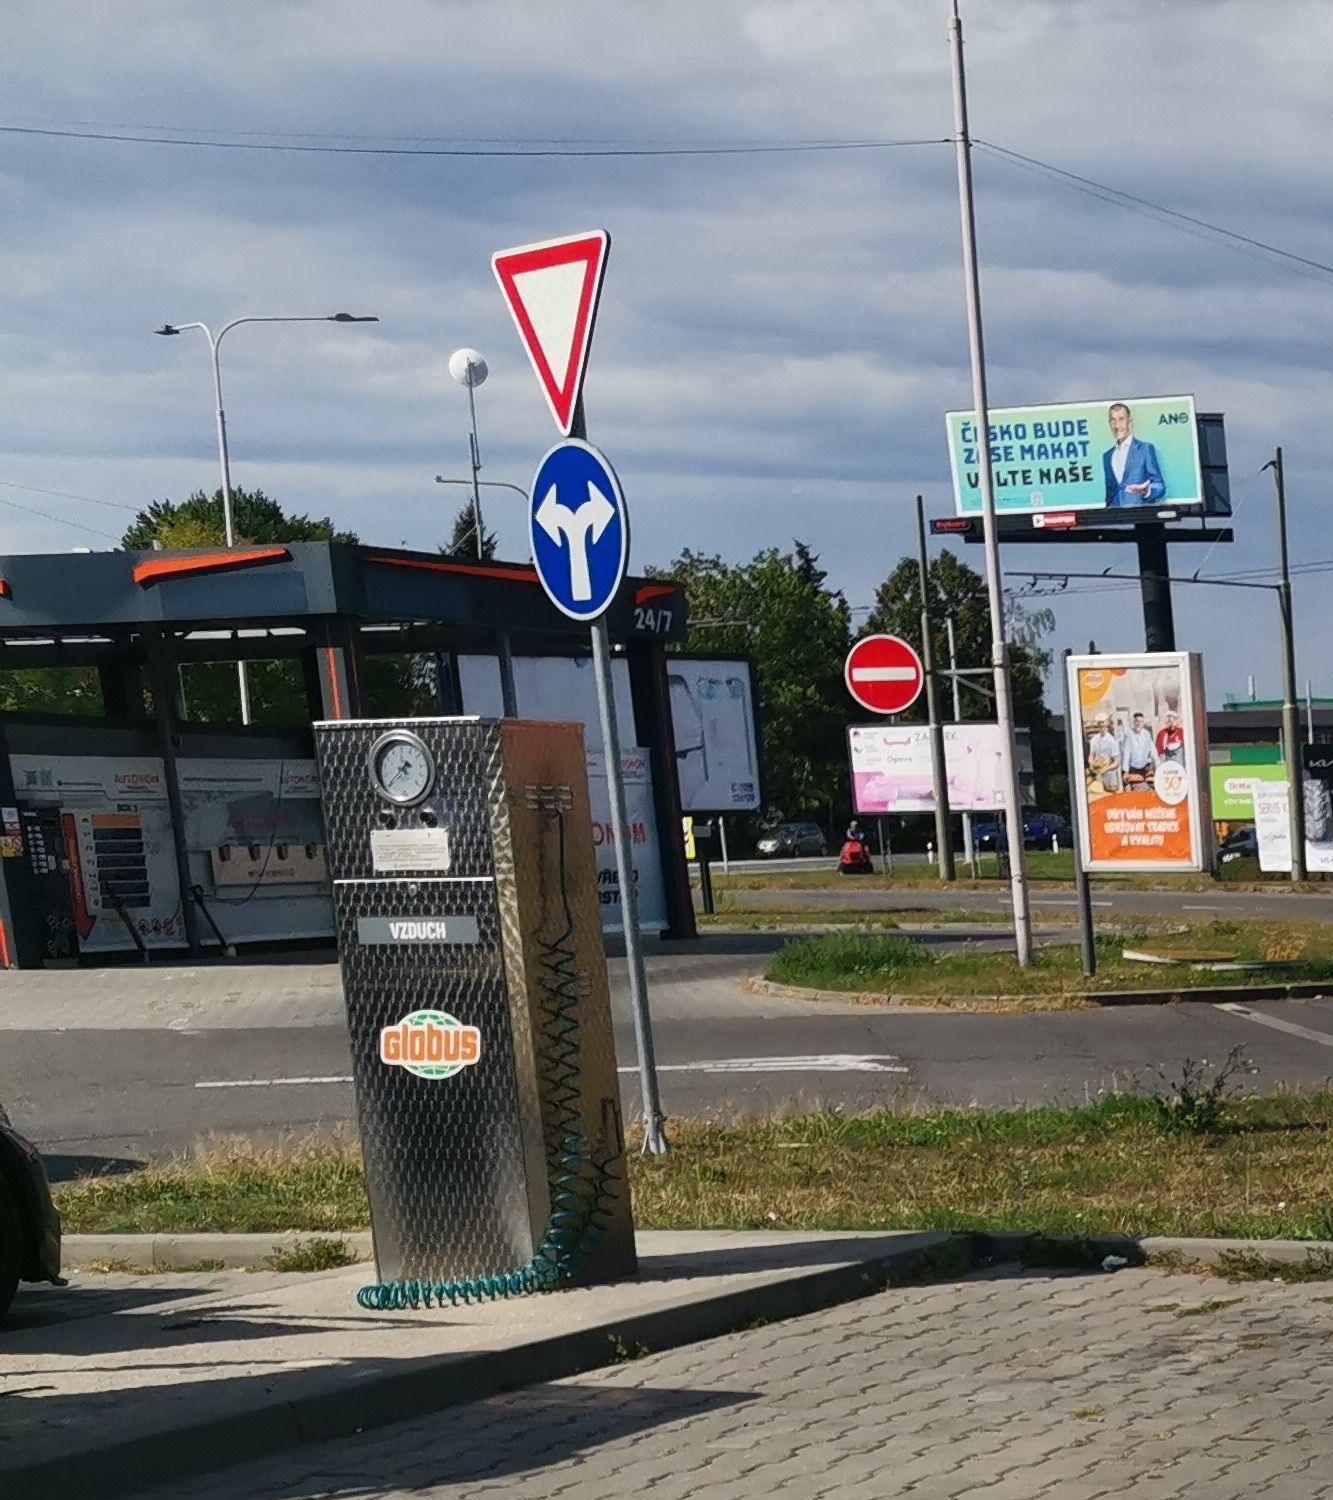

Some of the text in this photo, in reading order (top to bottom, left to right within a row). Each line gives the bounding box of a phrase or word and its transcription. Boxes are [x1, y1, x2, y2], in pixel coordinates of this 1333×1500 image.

[1033, 419, 1089, 440] BUDE
[964, 440, 1091, 465] ZSE MAKAT
[967, 461, 1094, 489] VLTE NAŠE
[633, 607, 673, 633] 24/7
[389, 921, 448, 940] VZDUCH
[384, 1023, 479, 1062] Globus
